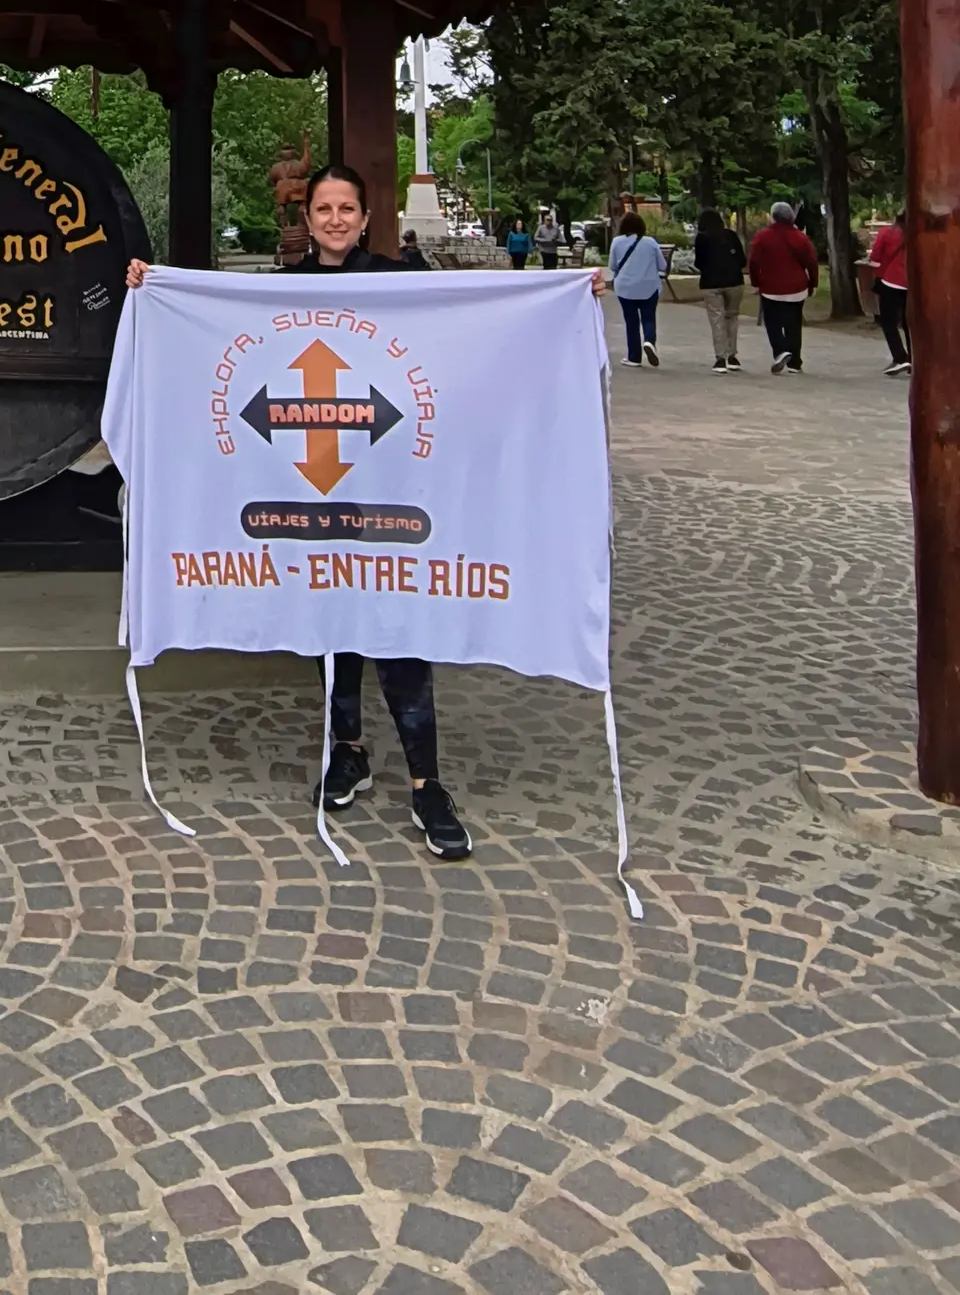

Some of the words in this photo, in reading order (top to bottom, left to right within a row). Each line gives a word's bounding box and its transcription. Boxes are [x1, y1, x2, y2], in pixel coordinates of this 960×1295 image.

[272, 308, 377, 339] SUEÑA
[386, 337, 408, 358] Y
[406, 365, 438, 459] VIAJA
[269, 404, 375, 424] RANDOM
[248, 510, 309, 527] VIAJES
[319, 515, 330, 527] Y
[171, 544, 281, 588] PARANÁ
[307, 552, 419, 594] ENTRE
[428, 553, 510, 600] RÍOS
